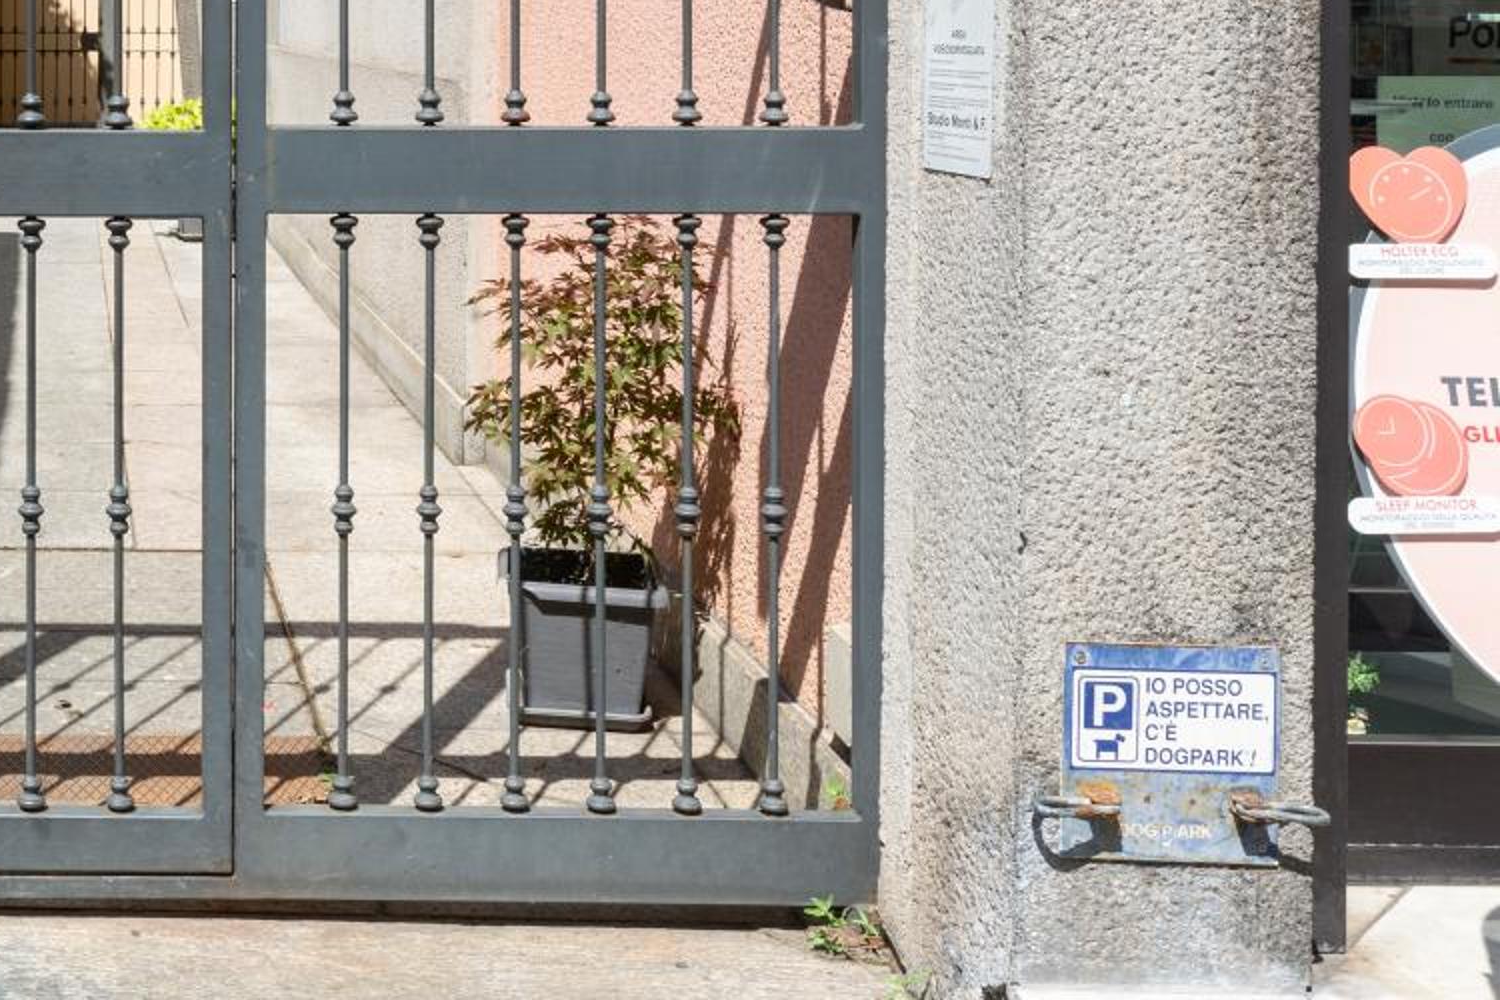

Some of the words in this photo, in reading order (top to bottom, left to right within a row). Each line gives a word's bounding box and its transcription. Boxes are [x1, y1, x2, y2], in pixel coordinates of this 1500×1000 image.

[1449, 16, 1500, 49] Po
[1463, 425, 1500, 443] GL
[1375, 500, 1410, 512] SLEEP
[1415, 499, 1477, 511] MONITOR
[1145, 677, 1166, 694] IO
[1173, 678, 1243, 696] POSSO
[1093, 684, 1127, 727] P
